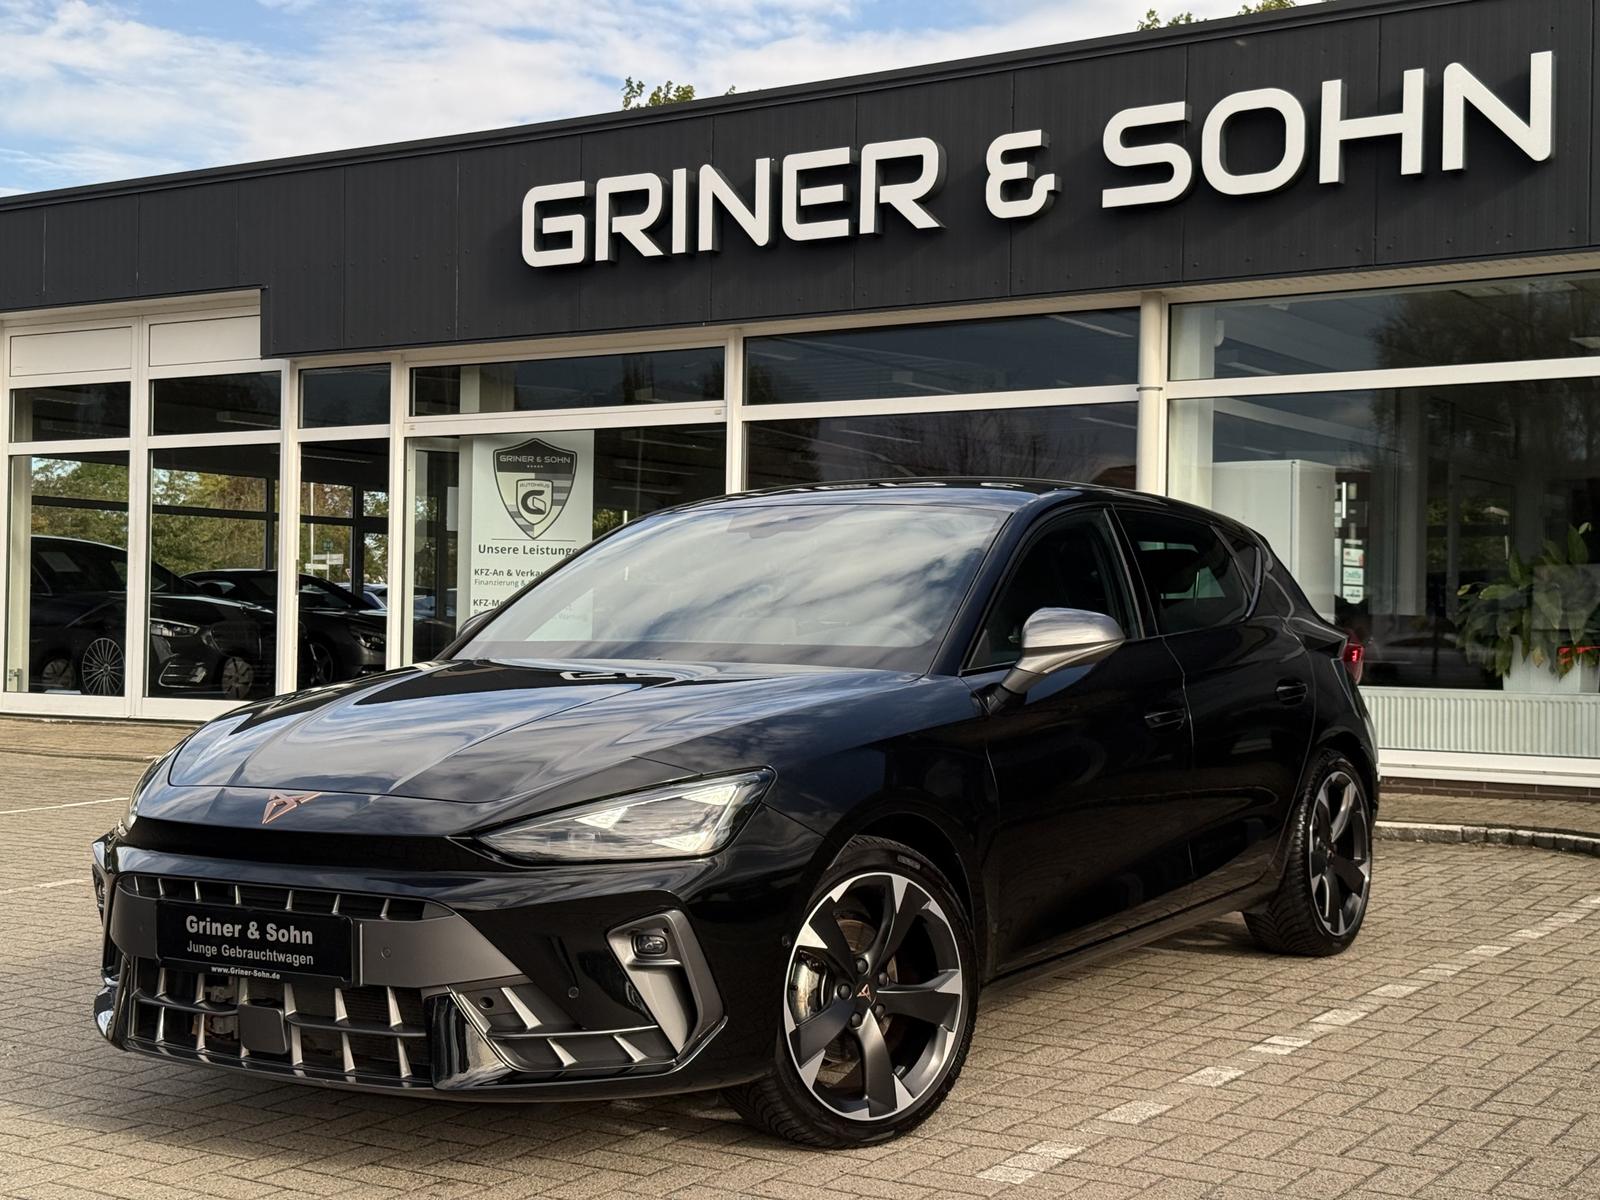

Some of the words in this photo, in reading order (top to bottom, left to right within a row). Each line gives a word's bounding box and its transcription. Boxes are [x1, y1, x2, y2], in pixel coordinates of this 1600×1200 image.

[521, 137, 941, 268] GRINER
[985, 129, 1056, 219] &
[1102, 50, 1554, 209] SOHN
[499, 454, 534, 463] GRINER
[543, 456, 571, 464] SOHN
[478, 544, 519, 555] Unsere
[474, 568, 504, 577] KFZ-An
[506, 569, 513, 577] &
[474, 578, 519, 588] Finanzierung
[185, 915, 242, 938] Griner
[247, 921, 260, 940] &
[266, 922, 313, 945] Sohn
[186, 939, 218, 957] Junge
[221, 944, 314, 967] Gebrauchtwagen
[211, 966, 281, 980] www.Griner-Sohn.de
